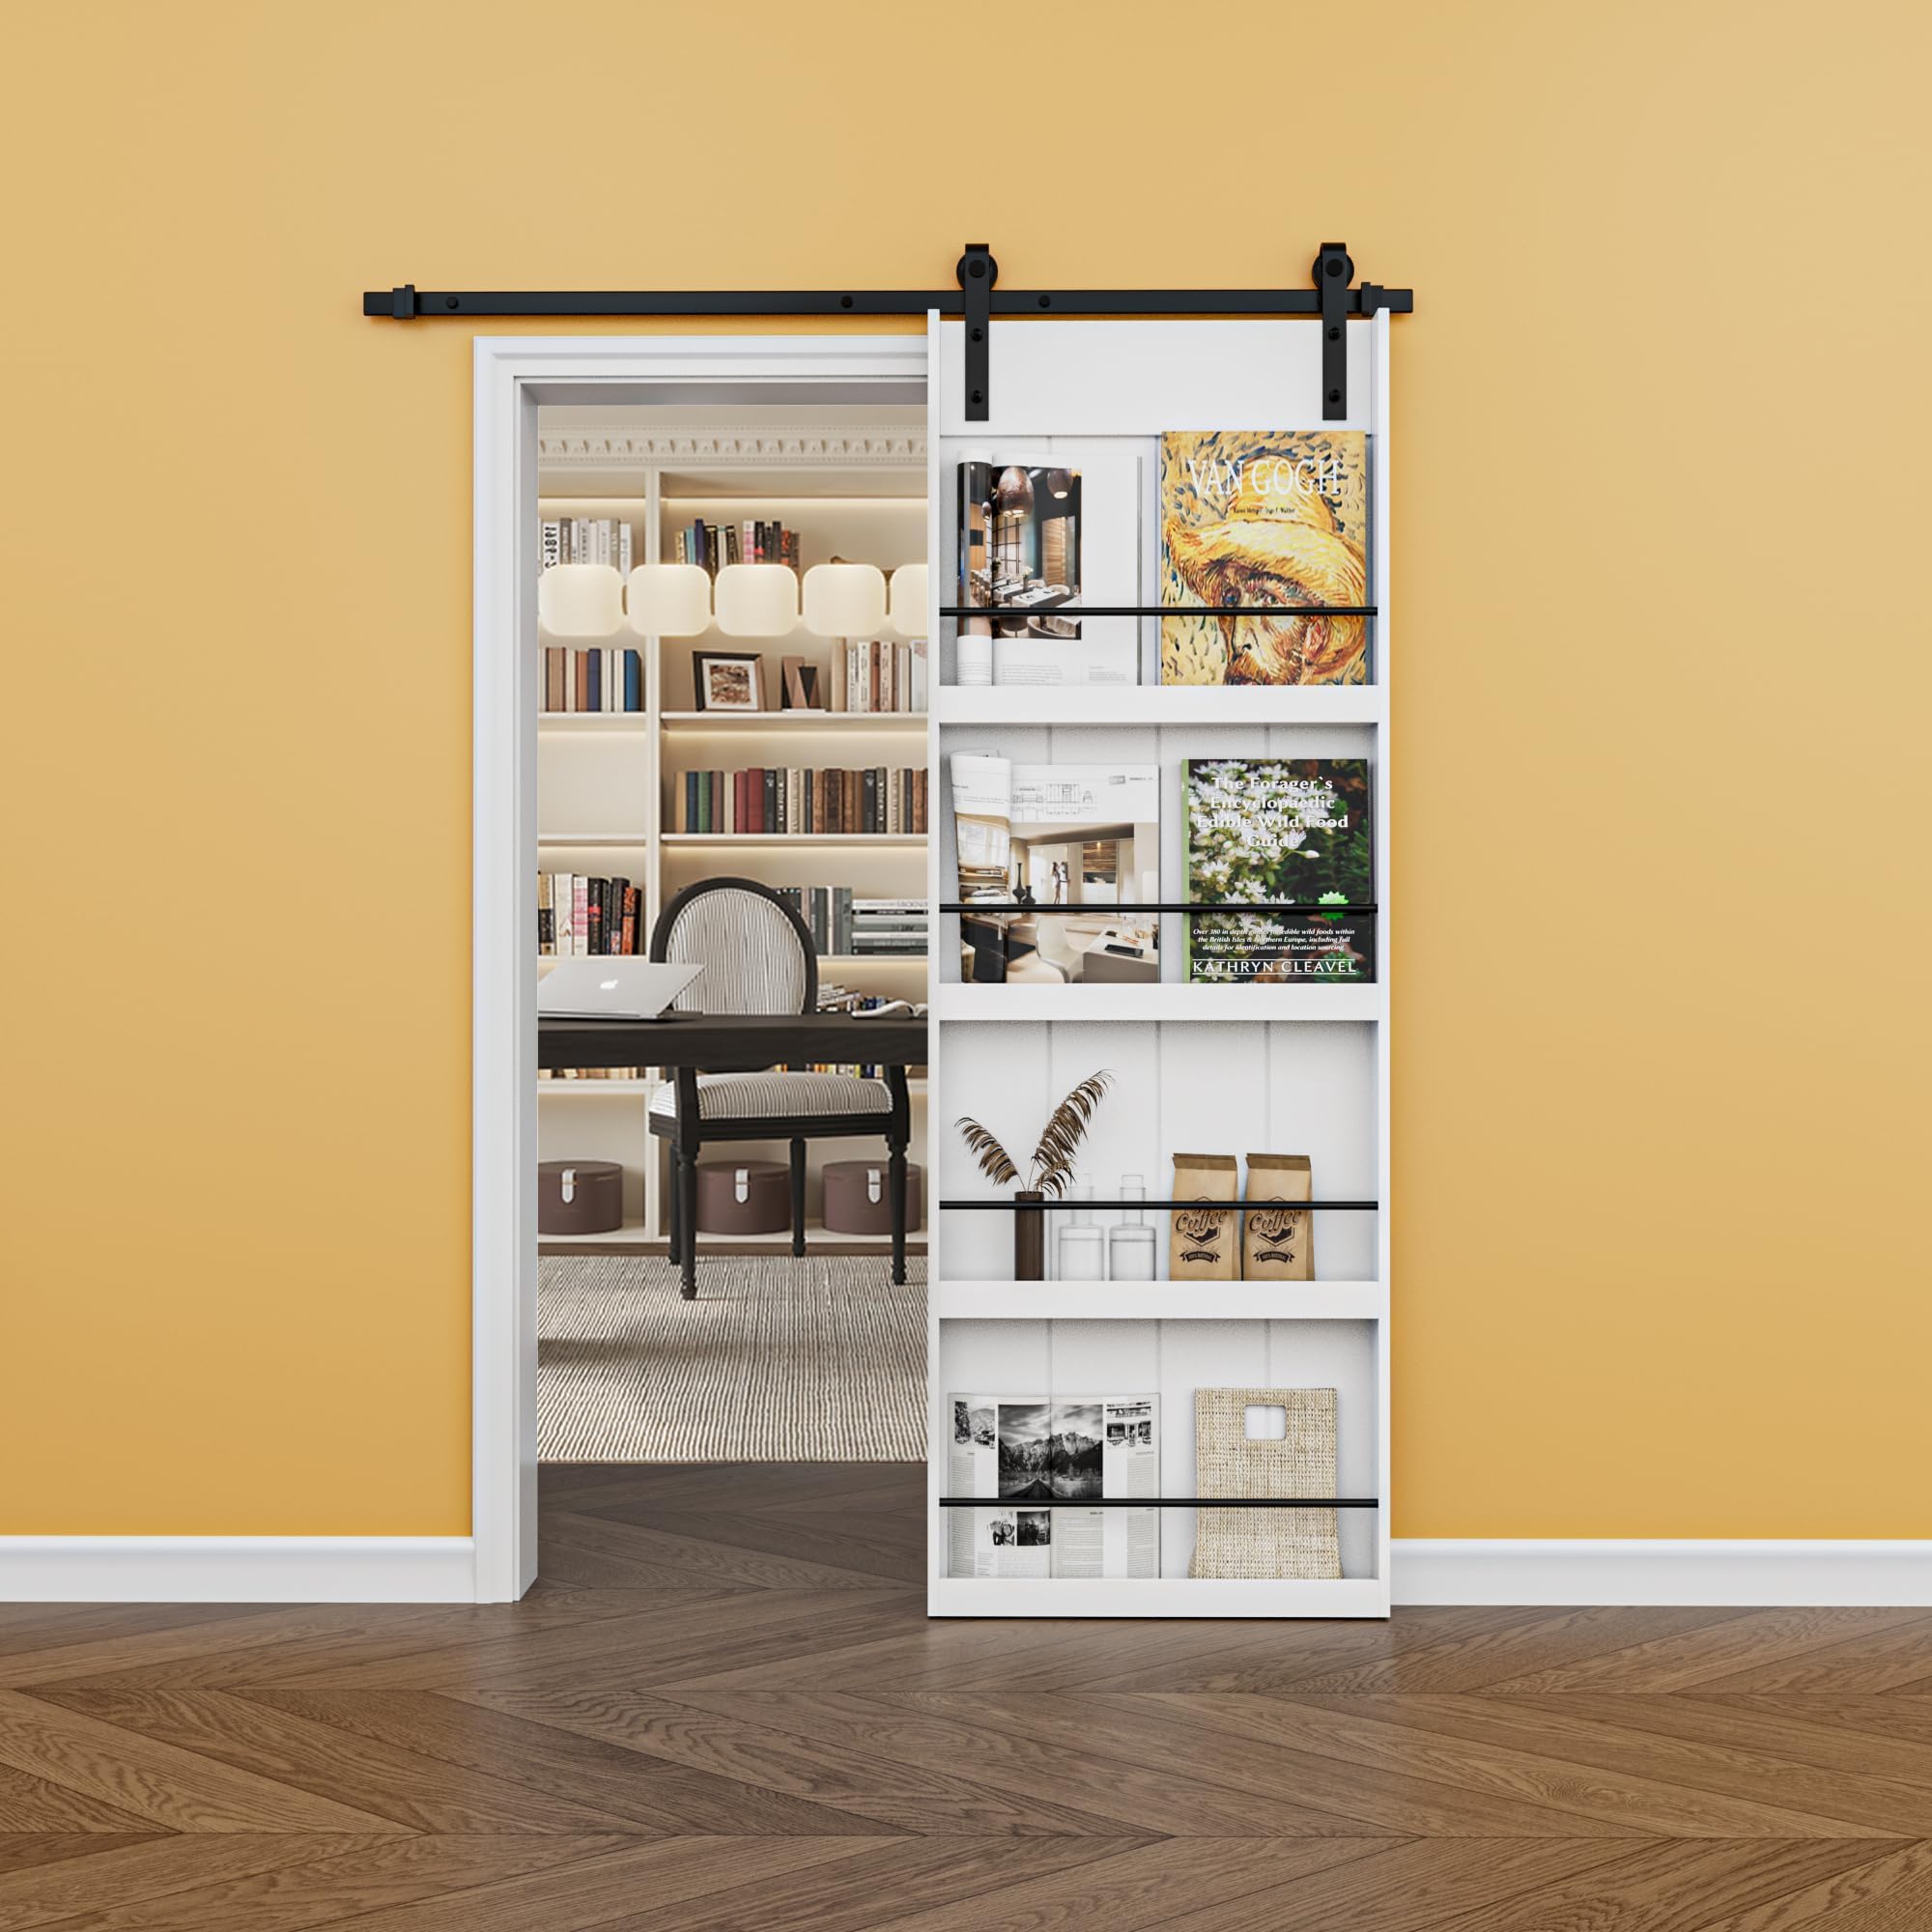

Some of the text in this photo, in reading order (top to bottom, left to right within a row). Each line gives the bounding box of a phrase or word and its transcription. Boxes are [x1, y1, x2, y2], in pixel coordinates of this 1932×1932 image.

[1188, 459, 1339, 496] VAN GOGH
[1211, 777, 1244, 789] The
[1210, 796, 1335, 811] Encyclopaedic
[1198, 814, 1349, 828] Edible Wild Food
[1247, 835, 1299, 847] Guide
[1230, 928, 1247, 937] depth
[1316, 928, 1334, 937] foods
[1309, 936, 1338, 945] including
[1193, 961, 1356, 973] KATHRYN CLEAVEL
[1176, 1209, 1228, 1233] Coffee
[1249, 1209, 1302, 1233] Coffee
